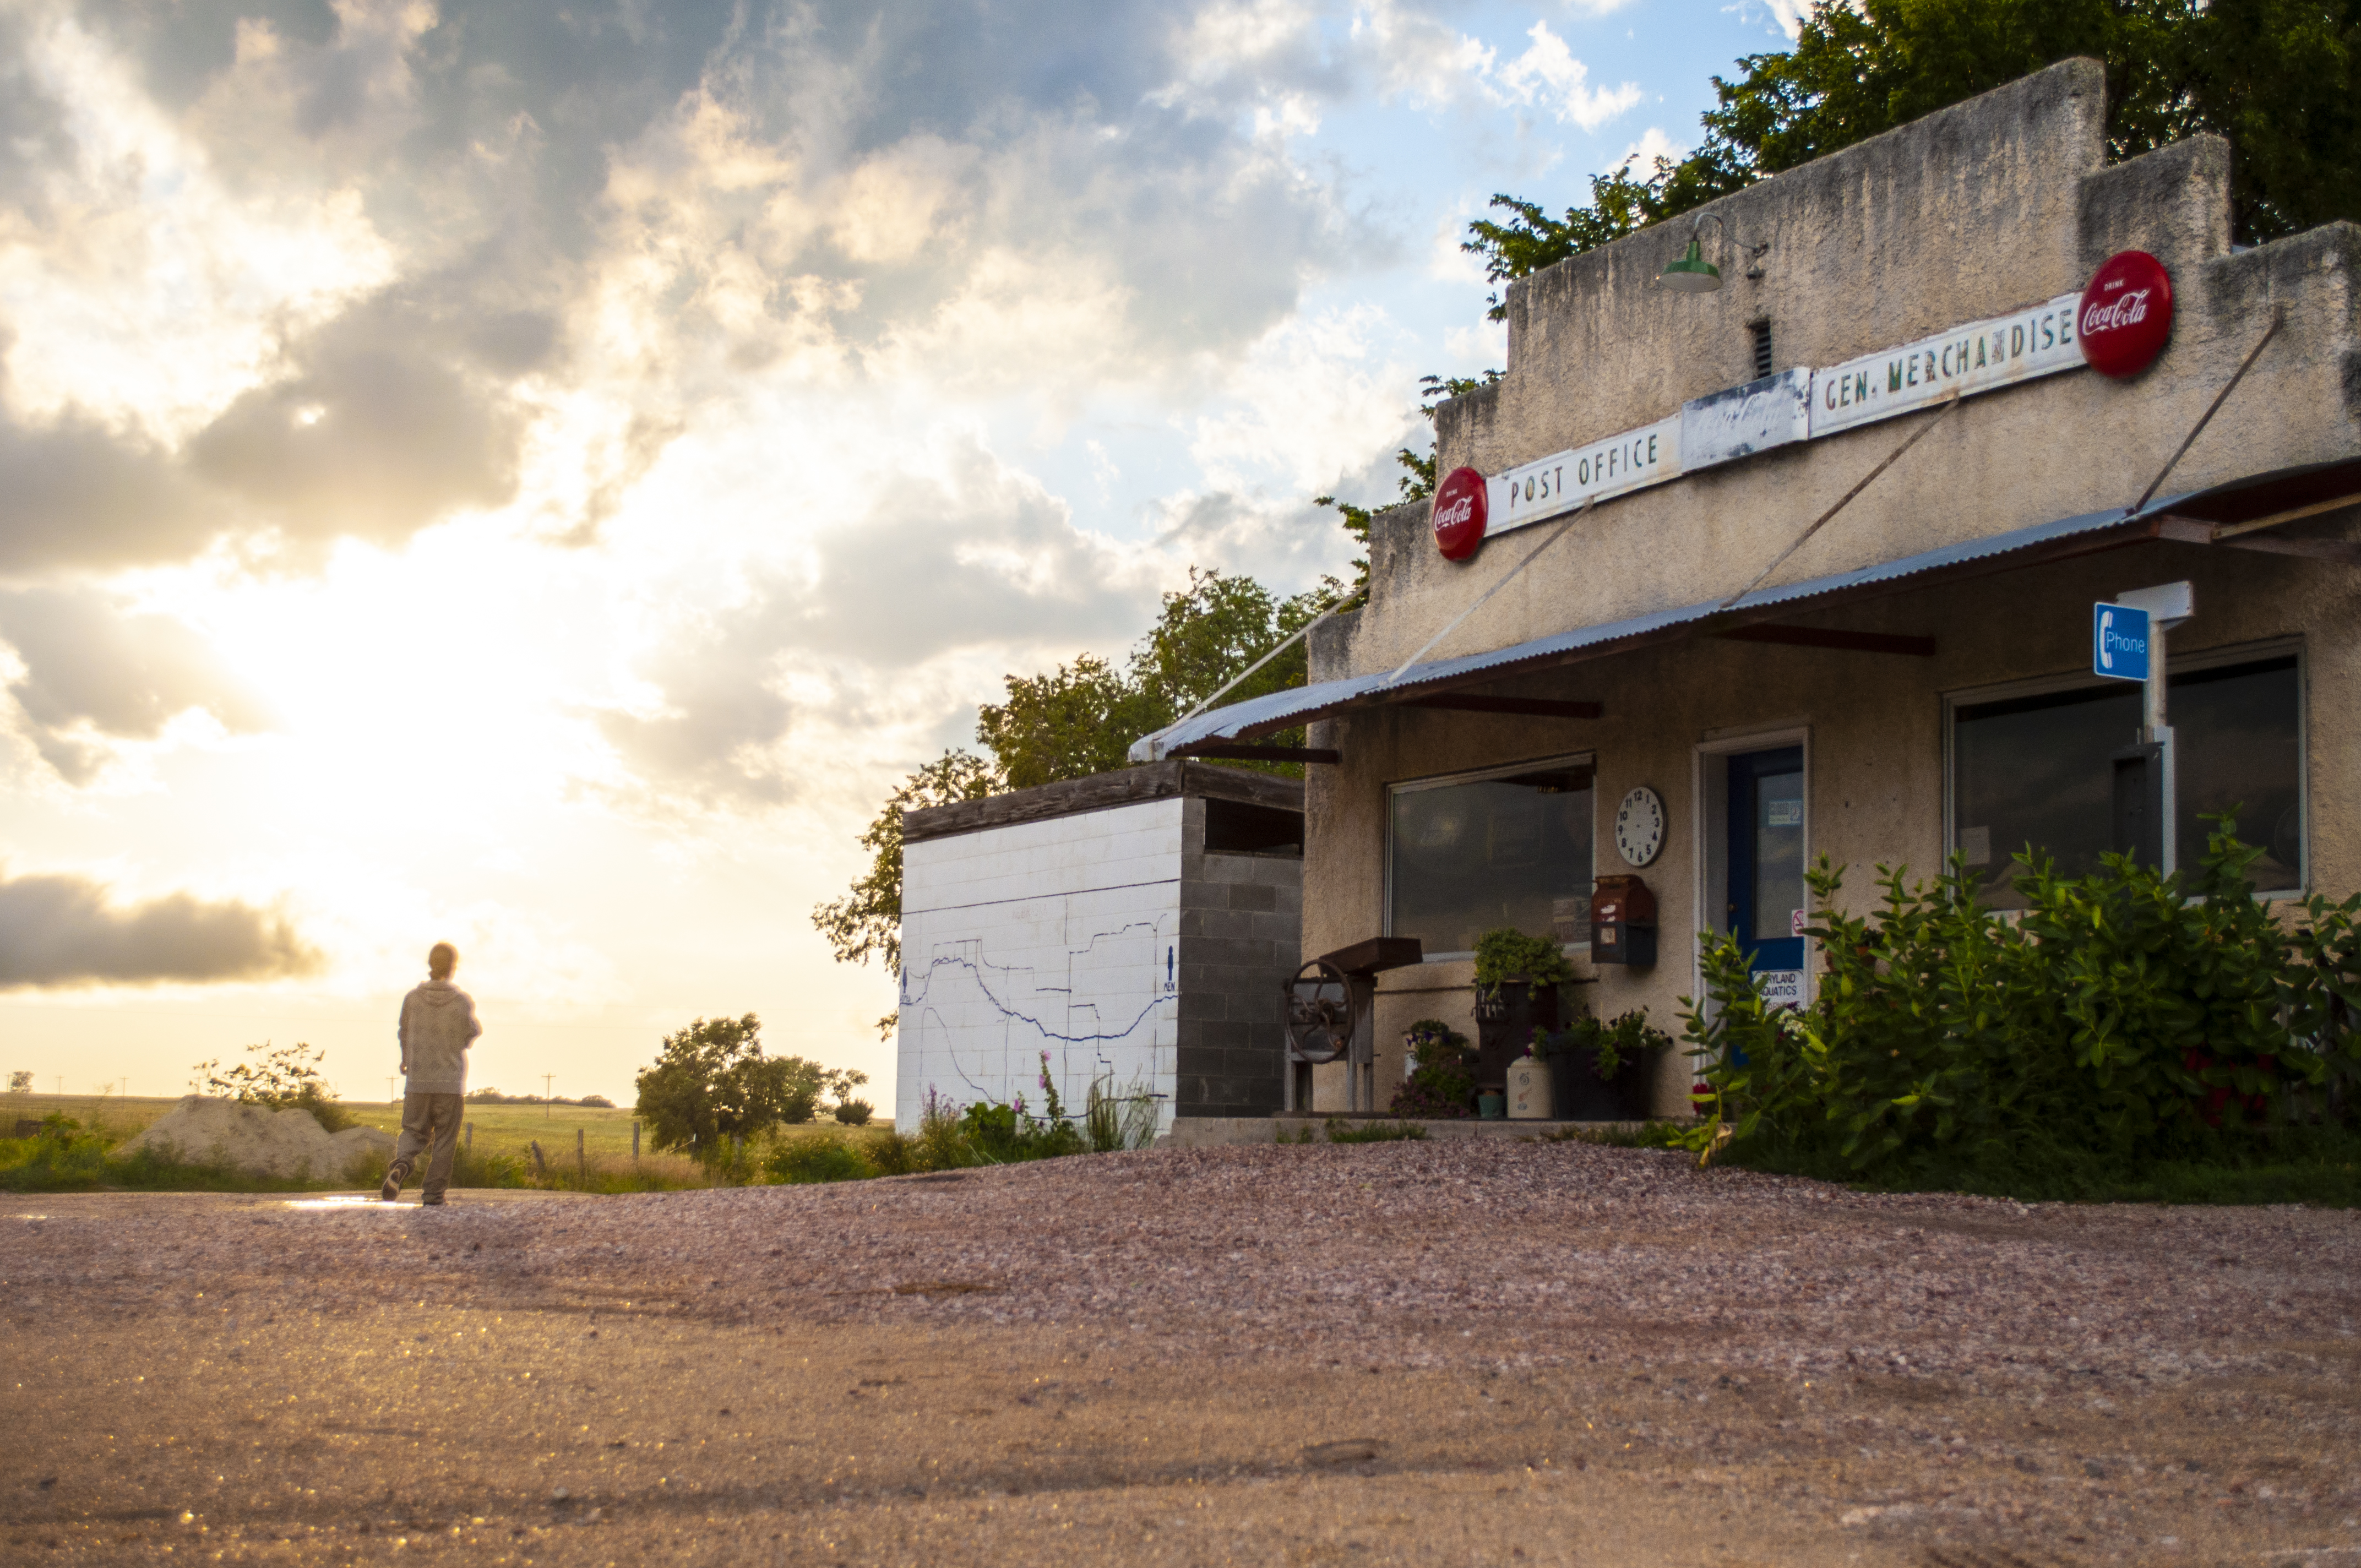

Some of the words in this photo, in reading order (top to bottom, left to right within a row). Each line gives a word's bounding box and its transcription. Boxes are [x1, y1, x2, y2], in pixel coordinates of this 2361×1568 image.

[2104, 280, 2124, 291] DRINK
[2082, 288, 2151, 336] Coca-Cola
[1825, 371, 1876, 411] GEN.
[1887, 308, 2073, 393] MERCHANDISE
[1511, 465, 1563, 508] POST
[1579, 433, 1657, 487] OFFICE
[1446, 488, 1458, 498] DRINK
[1434, 496, 1474, 531] Coca-Cola
[2106, 631, 2145, 653] Phone
[1634, 790, 1642, 801] 12
[1646, 794, 1650, 804] 1
[1625, 798, 1632, 808] 11
[1652, 804, 1657, 814] 2
[1619, 810, 1628, 821] 10
[1655, 817, 1660, 827] 3
[1618, 825, 1623, 835] 9
[1652, 831, 1657, 841] 4
[1622, 838, 1626, 848] 8
[1629, 847, 1634, 858] 7
[1646, 844, 1651, 855] 5
[1638, 851, 1643, 862] 6
[1762, 973, 1796, 984] RYLAND
[1163, 982, 1176, 992] MEN
